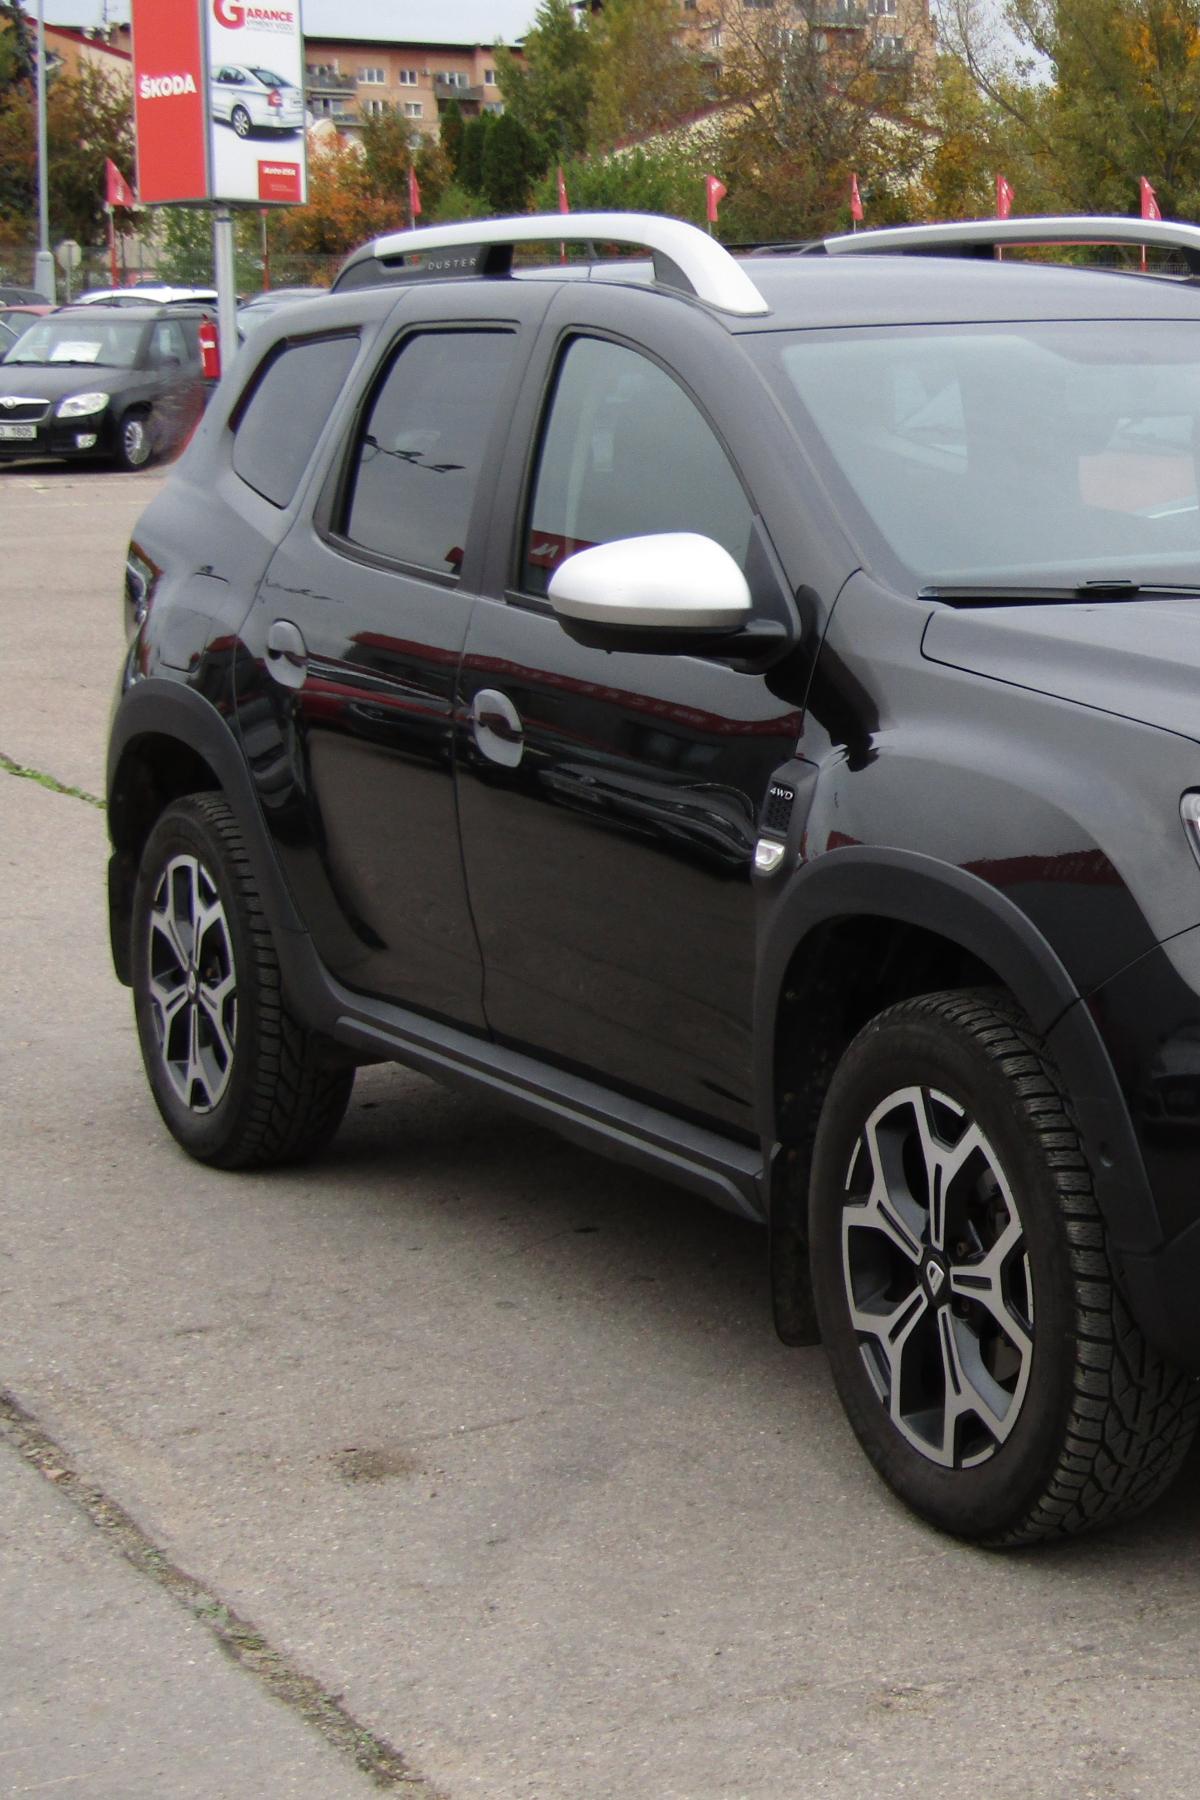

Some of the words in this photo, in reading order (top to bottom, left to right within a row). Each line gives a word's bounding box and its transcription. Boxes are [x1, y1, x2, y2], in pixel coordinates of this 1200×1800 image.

[140, 74, 198, 99] ŠKODA
[428, 258, 477, 270] DUSTER
[770, 787, 793, 800] 4WD
